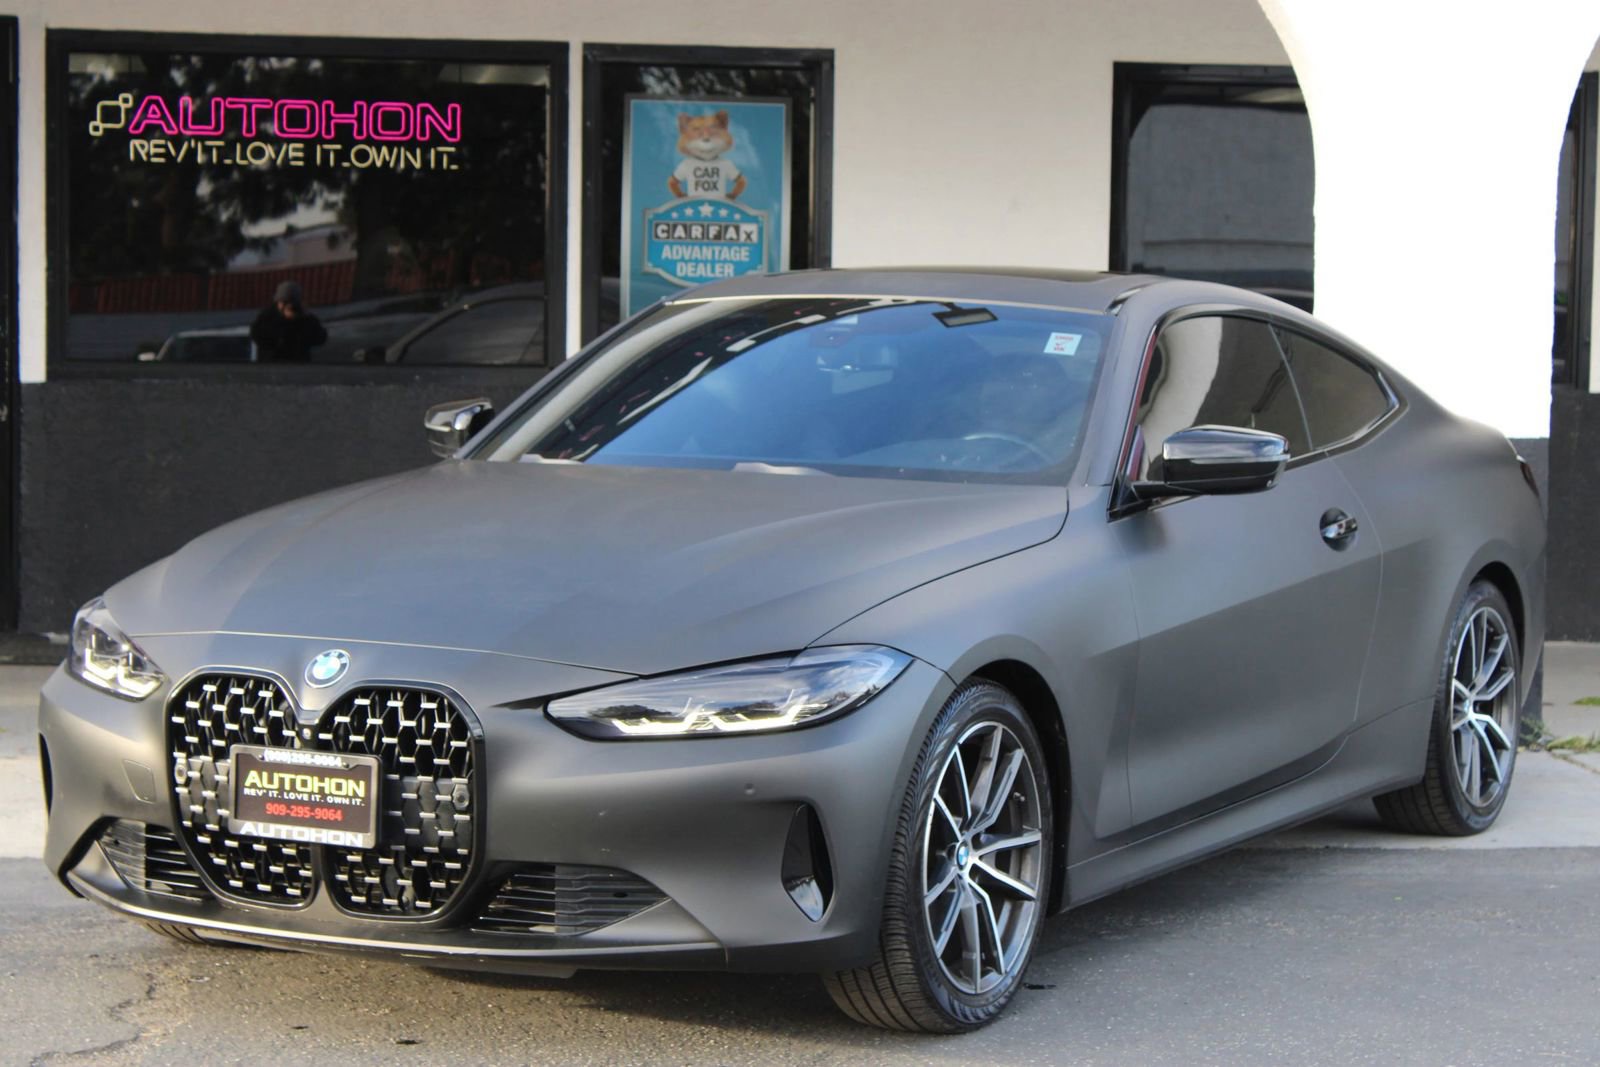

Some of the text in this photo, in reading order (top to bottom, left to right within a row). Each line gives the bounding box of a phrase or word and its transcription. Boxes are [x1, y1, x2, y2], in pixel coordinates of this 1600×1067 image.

[128, 95, 462, 142] AUTOHON
[693, 167, 720, 179] CAR
[694, 179, 719, 192] FOX
[655, 223, 757, 242] CARFAX
[661, 244, 750, 261] ADVANTAGE
[676, 261, 735, 277] DEALER
[244, 770, 365, 797] AUTOHON
[283, 791, 309, 801] LOVE
[326, 795, 350, 805] OWN
[265, 802, 344, 822] 909-295-9064
[240, 822, 362, 847] AUTOHON
